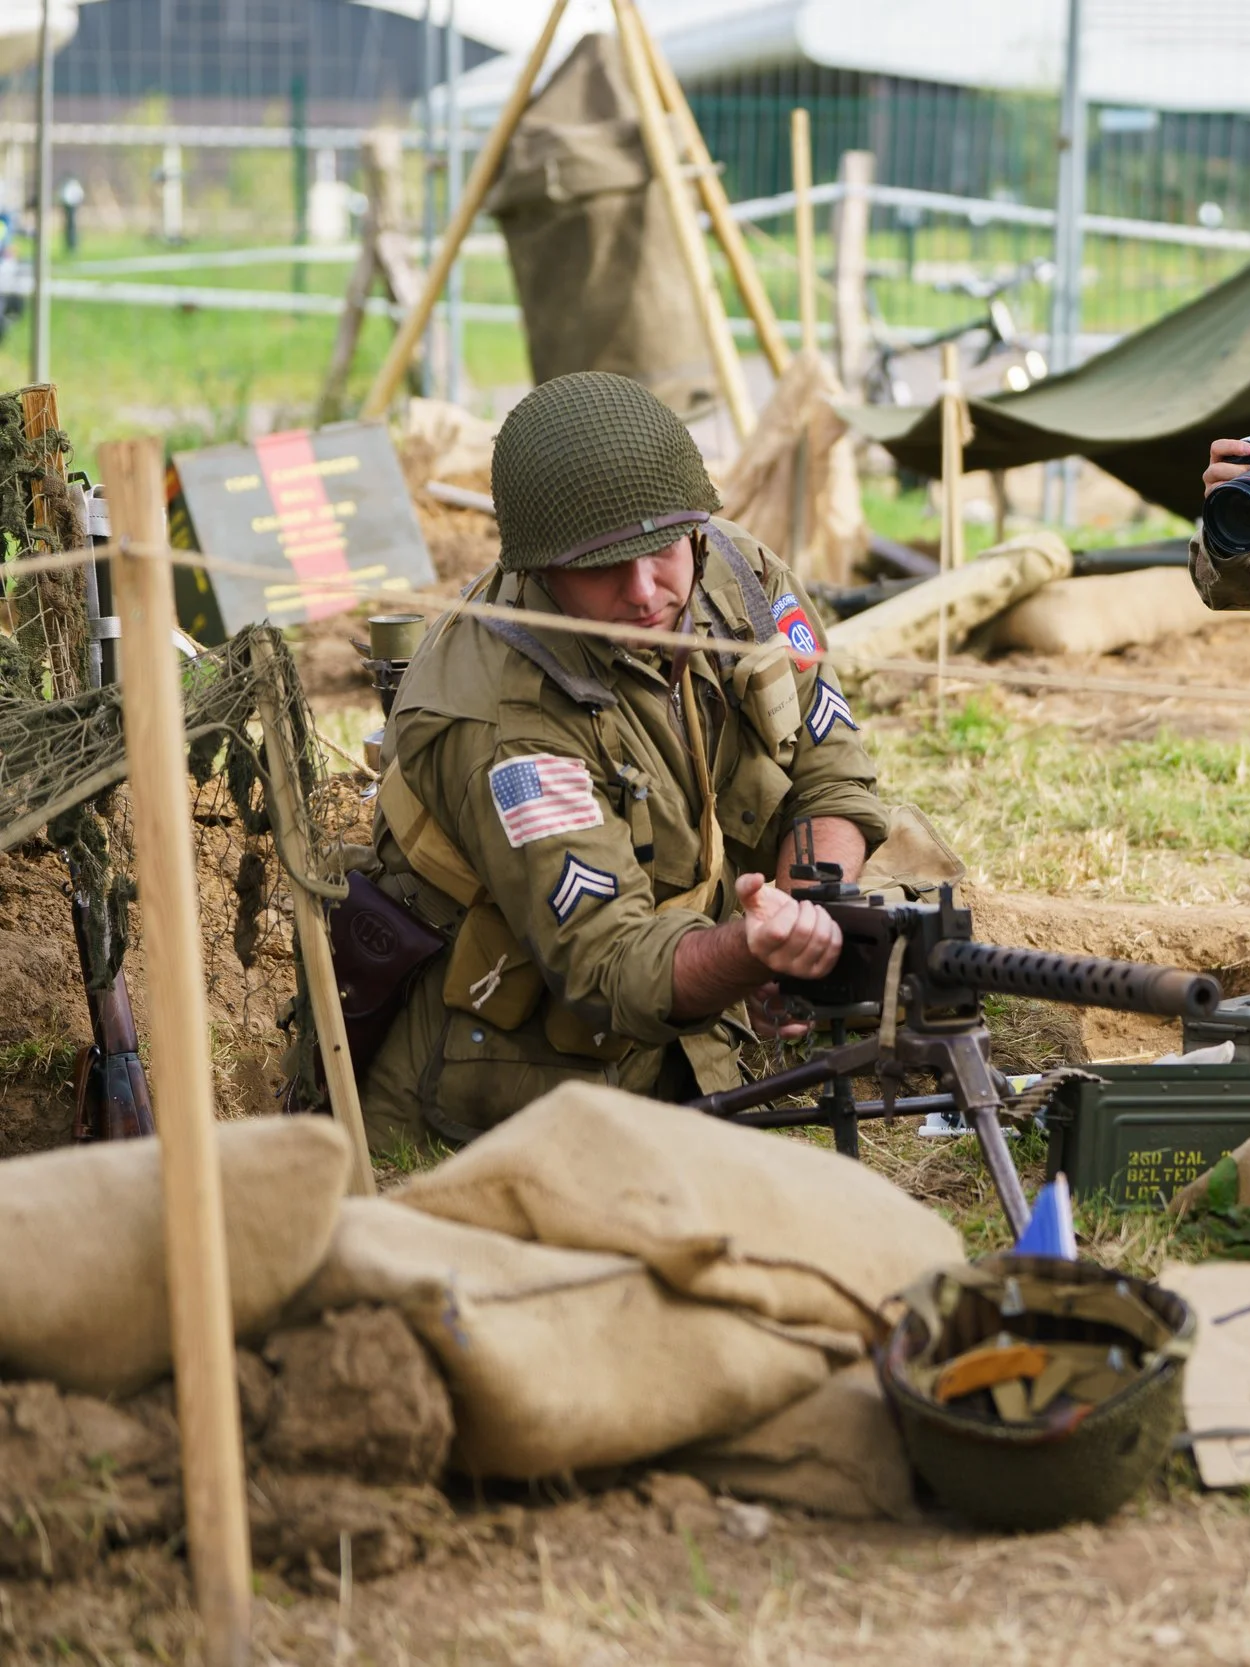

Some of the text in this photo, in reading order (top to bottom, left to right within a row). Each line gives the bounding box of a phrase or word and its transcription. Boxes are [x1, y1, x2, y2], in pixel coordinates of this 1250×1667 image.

[1173, 1151, 1207, 1165] CAL
[1126, 1168, 1198, 1183] BELTED
[1125, 1185, 1160, 1200] LOT
